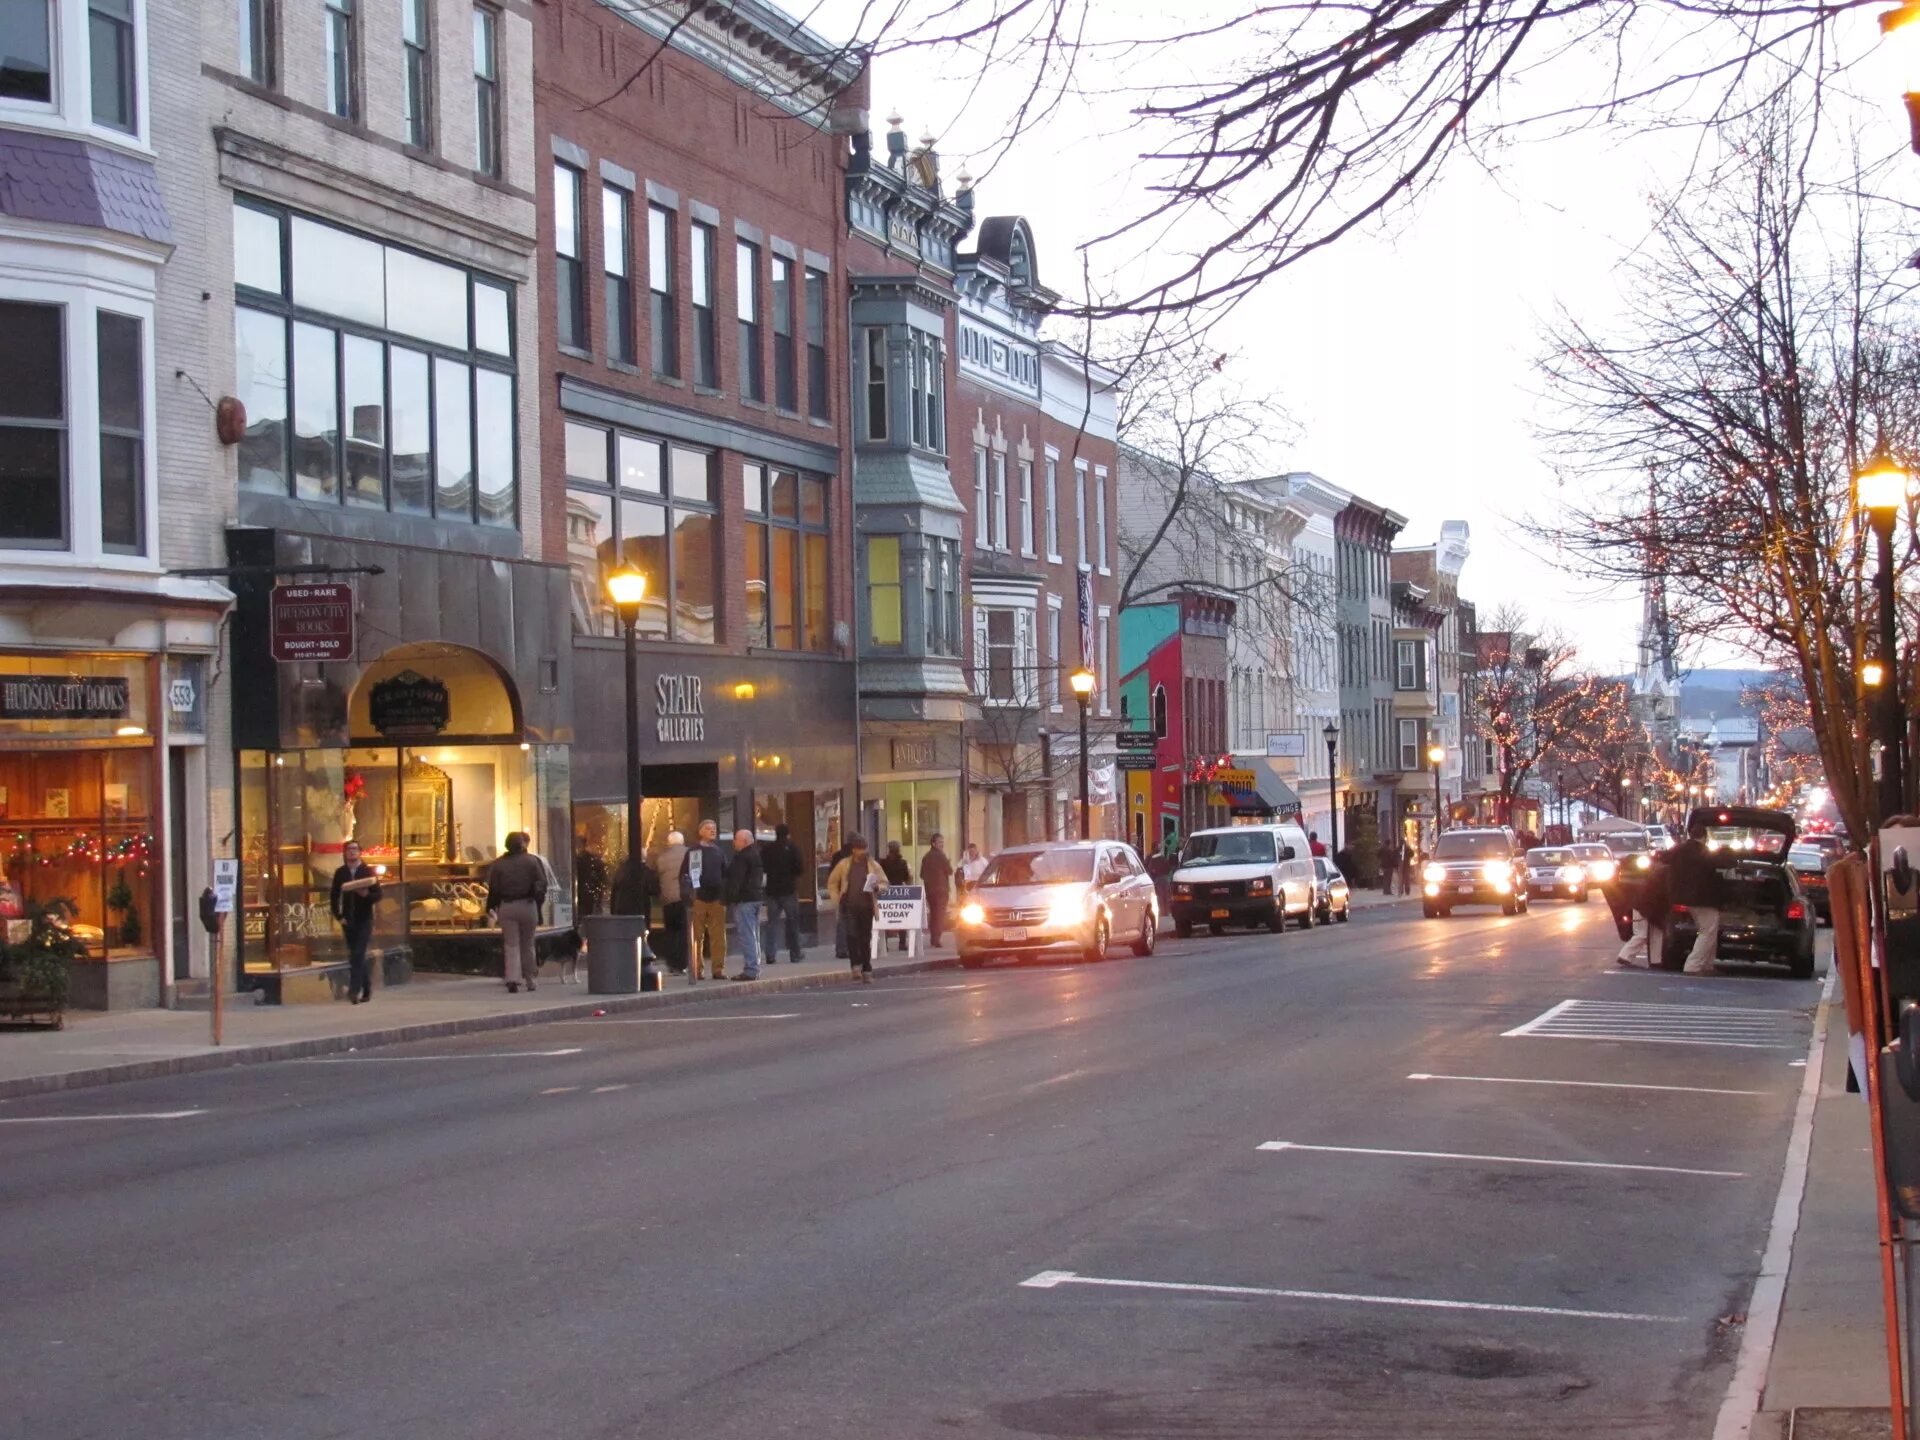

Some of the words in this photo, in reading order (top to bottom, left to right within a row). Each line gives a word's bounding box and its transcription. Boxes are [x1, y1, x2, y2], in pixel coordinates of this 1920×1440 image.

[286, 589, 309, 597] USED
[314, 588, 337, 596] RARE
[284, 641, 315, 649] BOUGHT
[320, 640, 340, 648] SOLD
[5, 683, 56, 711] HUDSON
[58, 683, 83, 710] CITY
[86, 684, 125, 710] BOOKS
[657, 673, 704, 715] STAIR
[657, 718, 704, 742] GALLERIES
